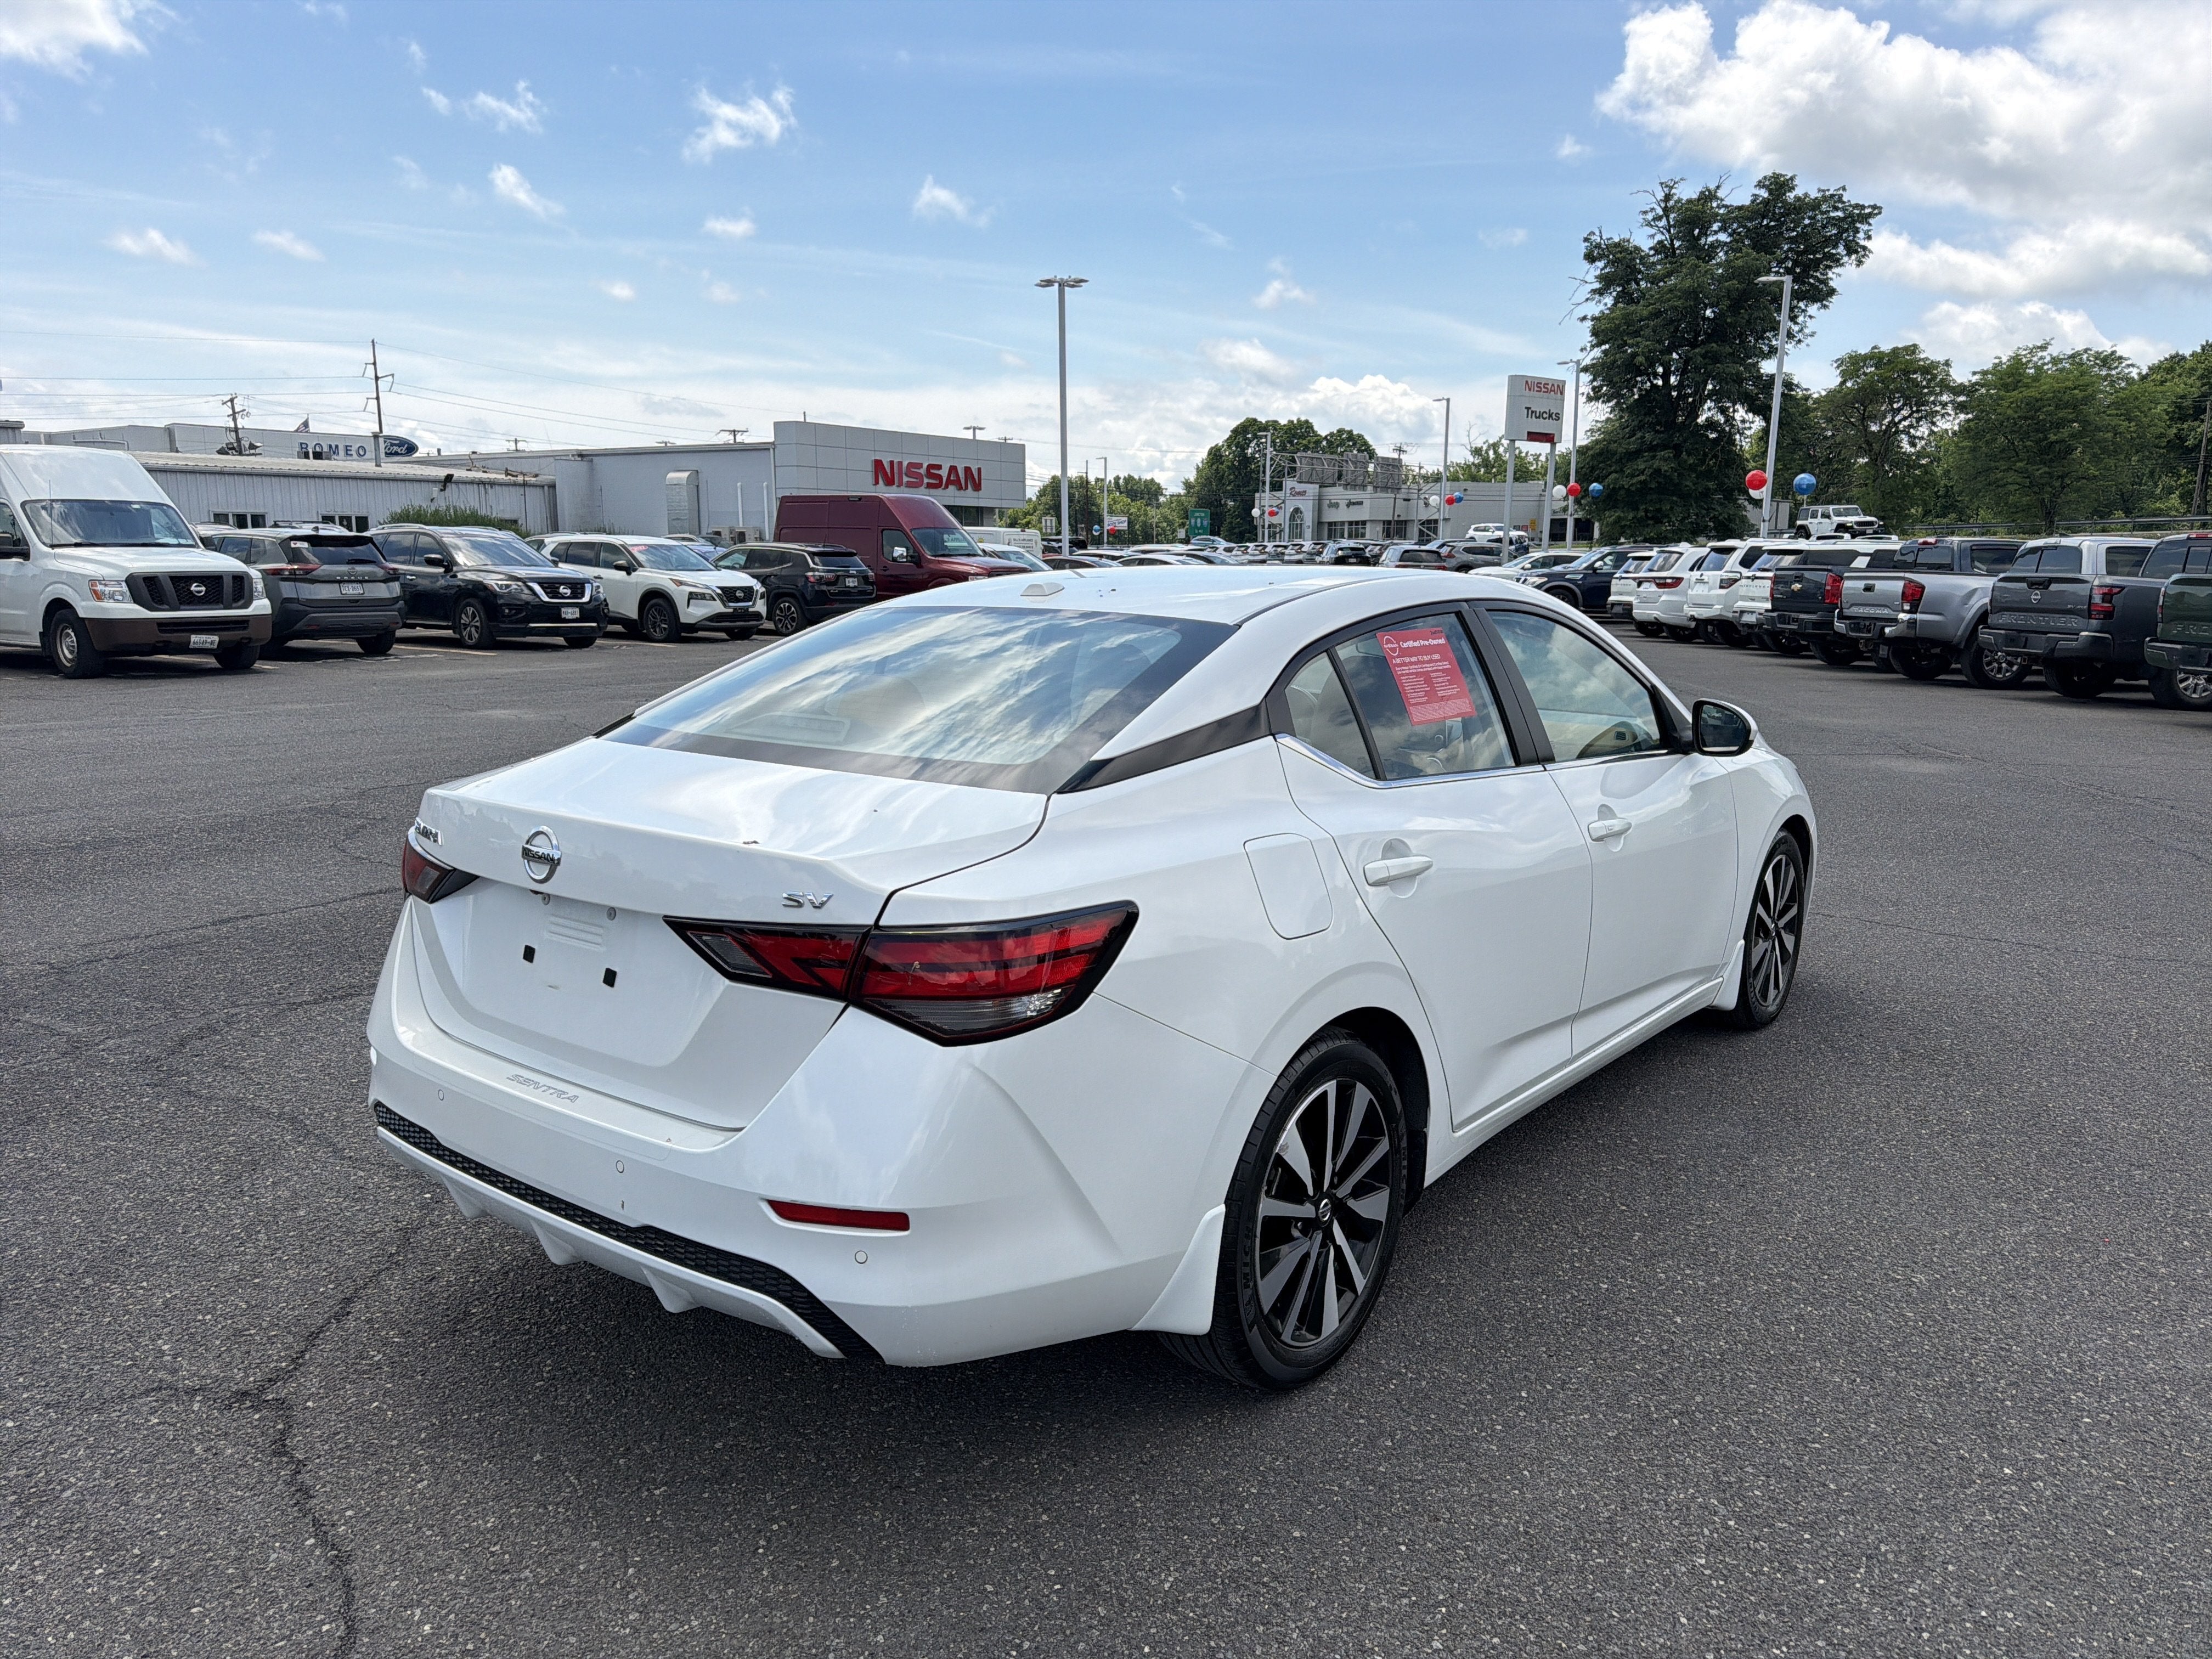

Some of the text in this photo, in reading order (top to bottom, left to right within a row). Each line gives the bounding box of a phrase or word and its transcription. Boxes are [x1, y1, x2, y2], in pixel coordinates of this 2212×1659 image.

[1525, 380, 1564, 396] NISSAN
[1525, 407, 1560, 421] Trucks
[299, 442, 367, 457] ROMEO
[873, 459, 982, 492] NISSAN
[1999, 614, 2078, 627] FRONTIER
[1400, 637, 1446, 648] Certified Pre-Owned
[522, 847, 555, 865] NISSAN
[781, 891, 834, 910] SV
[506, 1074, 579, 1103] SENTRA
